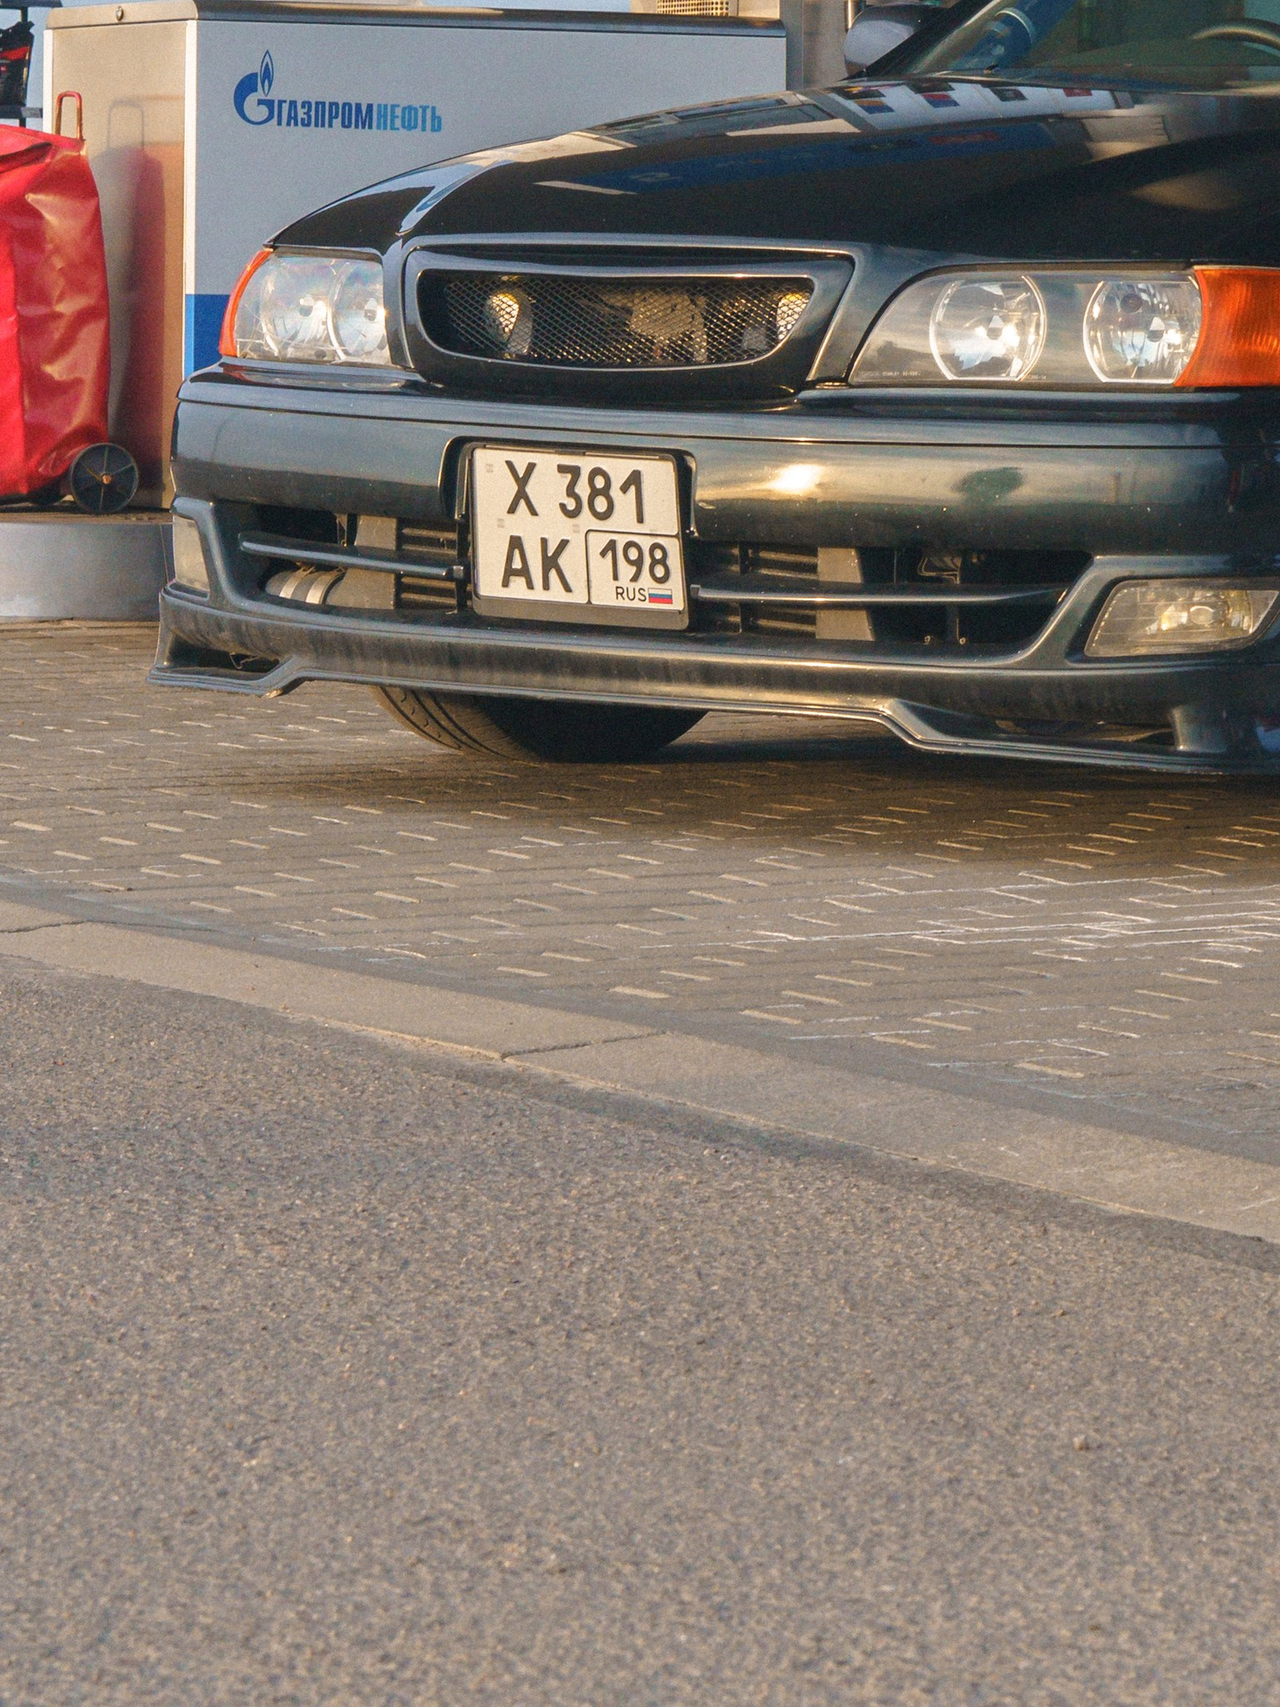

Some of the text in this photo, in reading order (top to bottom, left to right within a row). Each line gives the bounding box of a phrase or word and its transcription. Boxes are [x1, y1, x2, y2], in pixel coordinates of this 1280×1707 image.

[276, 98, 442, 133] ГАЗПРОМНЕФТЬ
[556, 463, 644, 524] 381
[599, 538, 670, 584] 198
[615, 585, 647, 602] RUS
